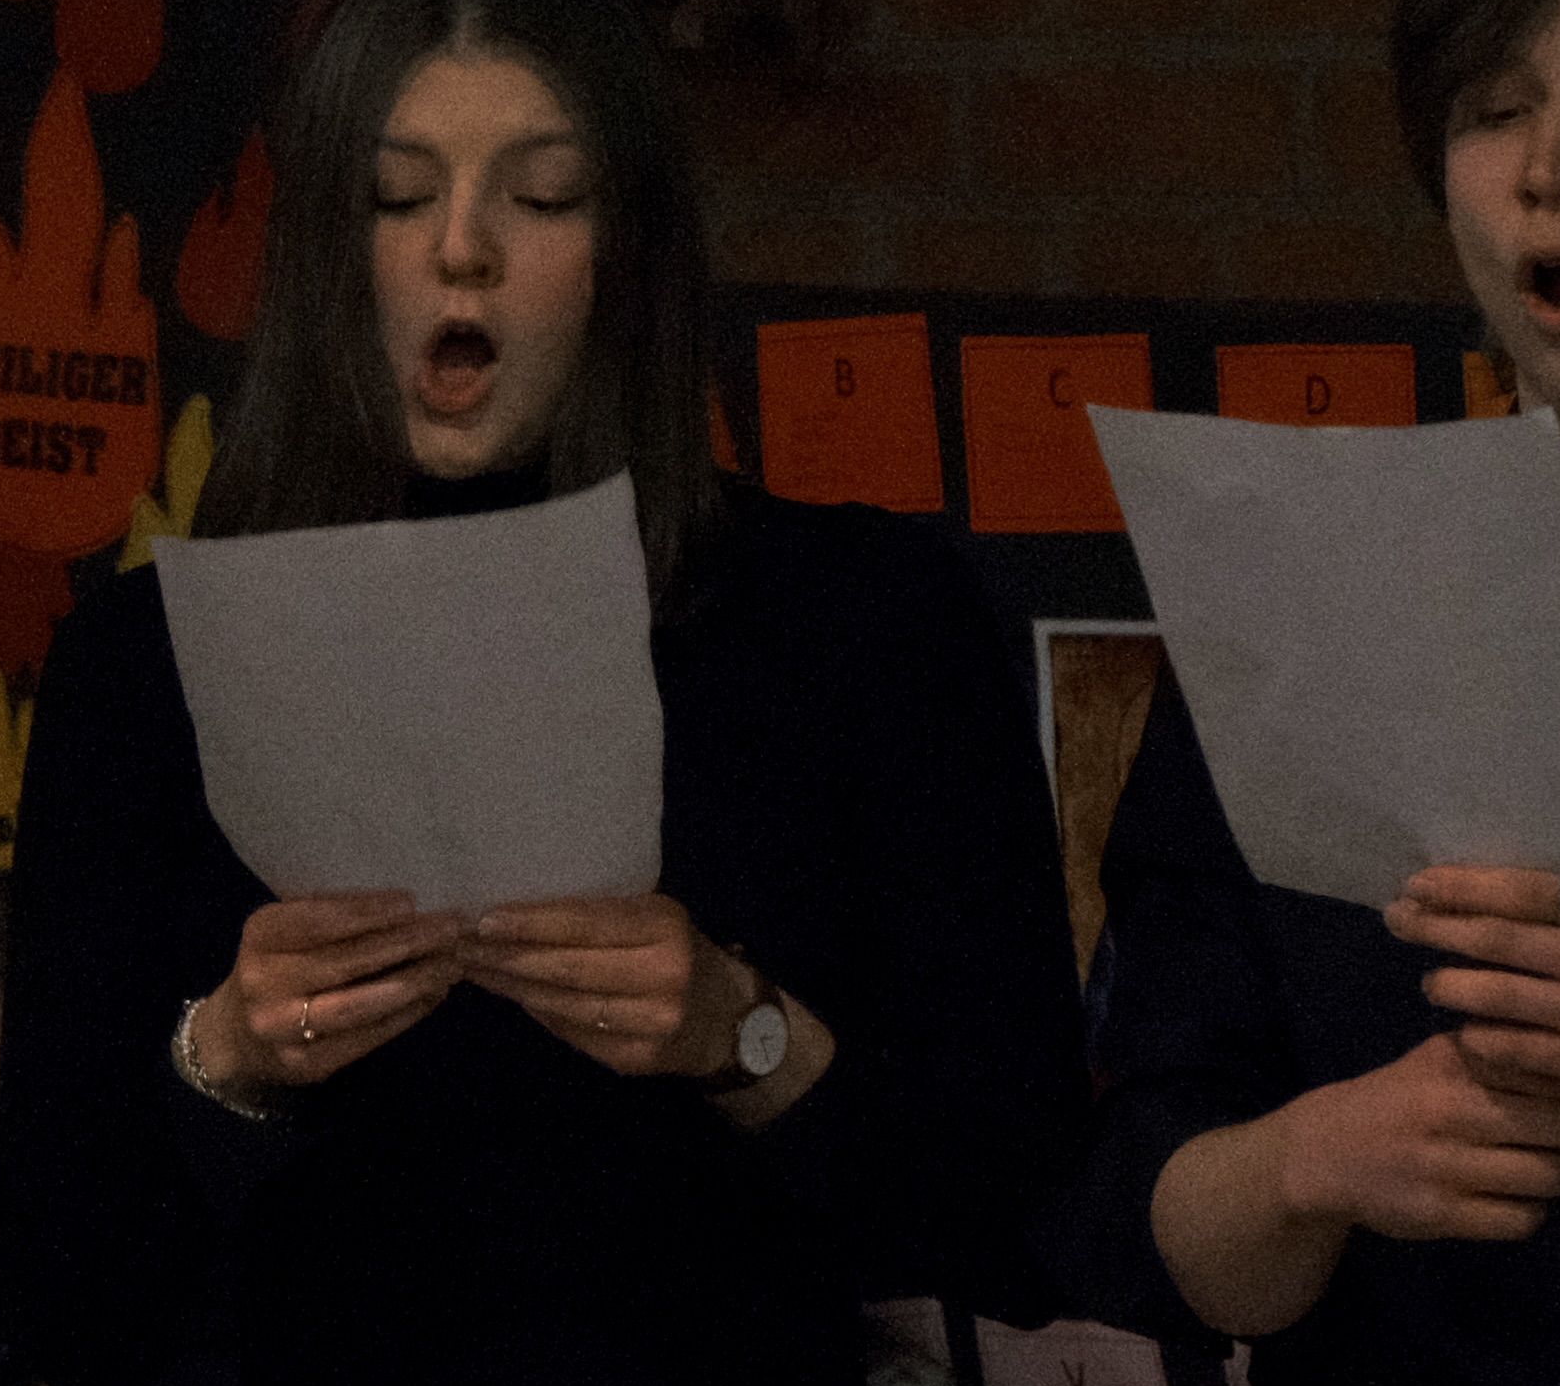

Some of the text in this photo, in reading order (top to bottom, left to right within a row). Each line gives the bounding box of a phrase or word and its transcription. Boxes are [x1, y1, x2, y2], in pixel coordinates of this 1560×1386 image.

[834, 357, 857, 397] B
[1048, 368, 1072, 409] C
[1305, 374, 1332, 416] D
